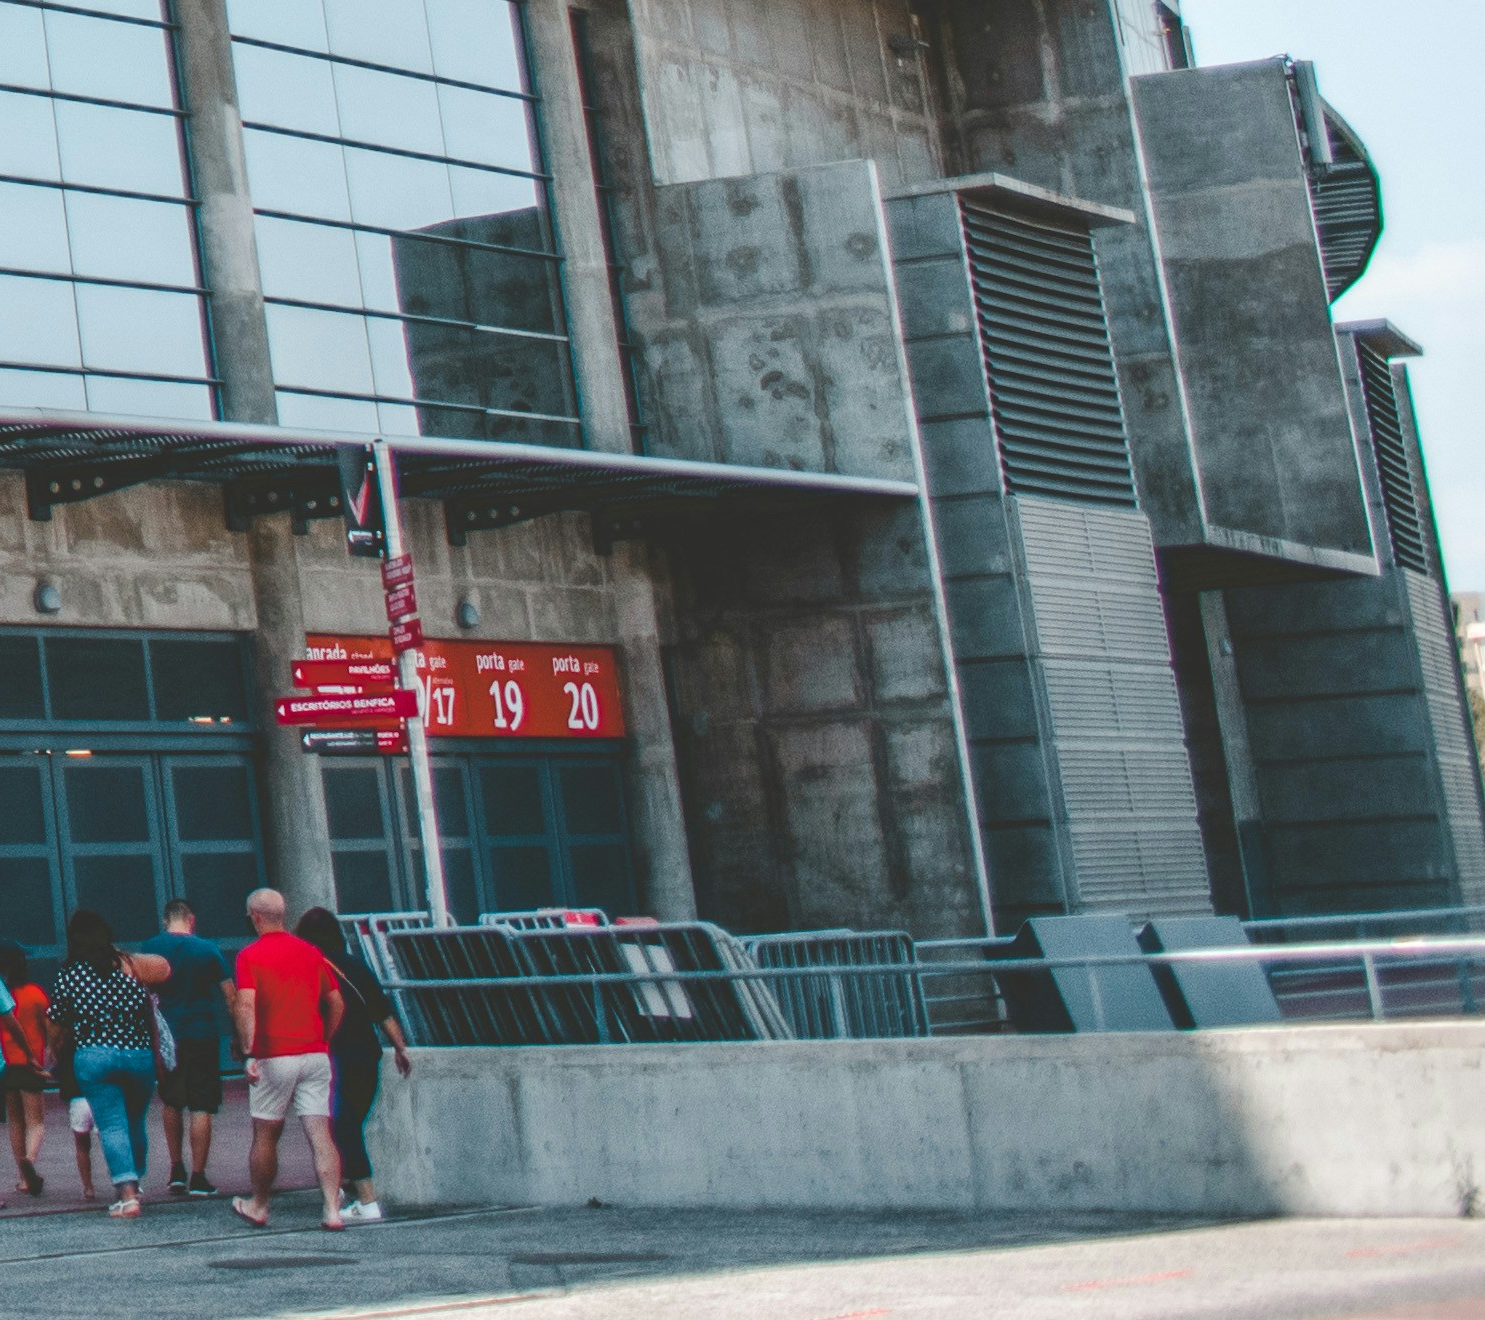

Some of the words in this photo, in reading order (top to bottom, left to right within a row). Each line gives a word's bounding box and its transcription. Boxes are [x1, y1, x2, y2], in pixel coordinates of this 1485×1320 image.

[475, 652, 506, 674] porta
[507, 658, 525, 674] gate
[552, 655, 581, 676] porta
[583, 661, 600, 676] gate
[290, 698, 352, 714] ESCRITÓRIOS
[353, 696, 396, 710] BENFICA
[488, 679, 524, 732] 19
[563, 681, 600, 731] 20
